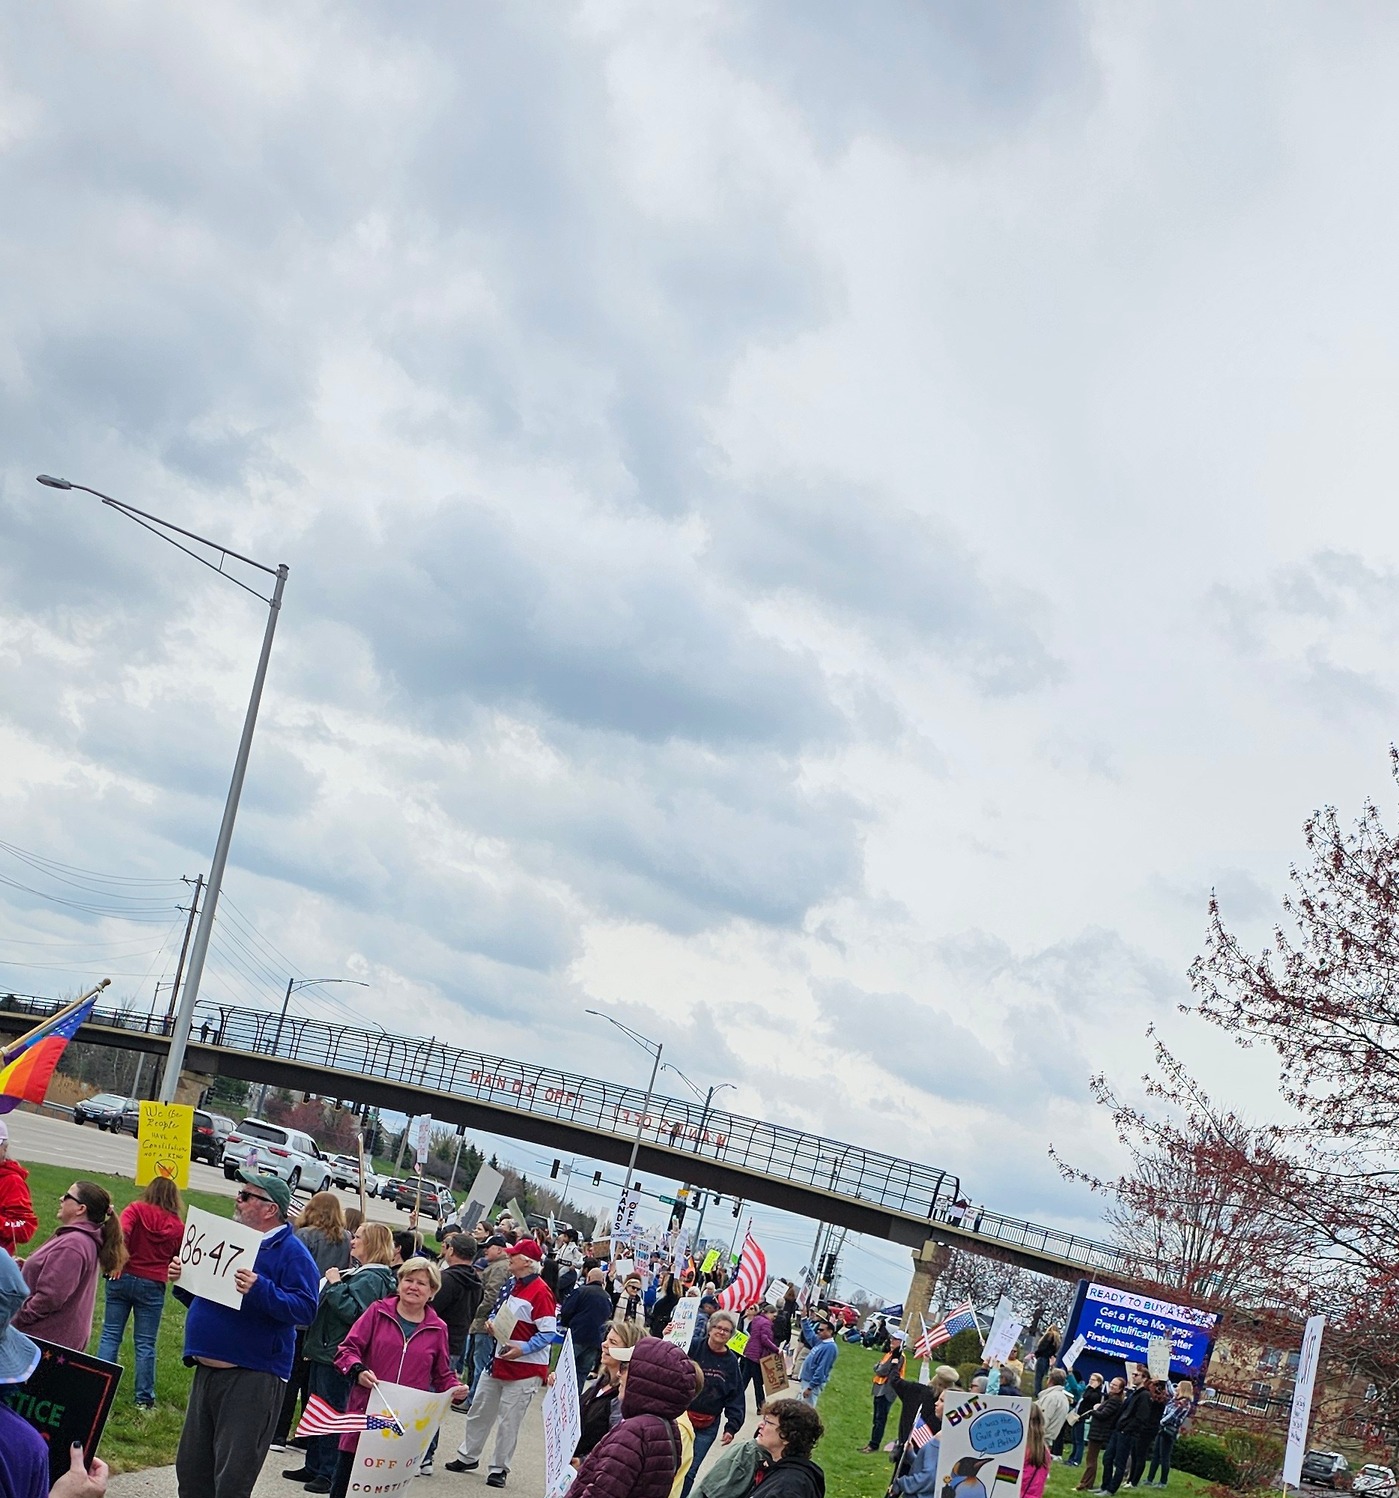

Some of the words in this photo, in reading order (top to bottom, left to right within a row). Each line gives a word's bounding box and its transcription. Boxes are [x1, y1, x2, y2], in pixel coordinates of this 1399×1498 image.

[468, 1069, 537, 1098] HANDS
[145, 1105, 163, 1117] We
[168, 1109, 183, 1119] the
[146, 1118, 180, 1130] People
[152, 1132, 168, 1140] HAVE
[142, 1139, 188, 1152] Constitution
[167, 1152, 184, 1160] KING
[613, 1188, 630, 1231] HANDS
[625, 1201, 639, 1227] OFF
[1089, 1288, 1126, 1303] READY
[1128, 1296, 1141, 1307] TO
[1143, 1301, 1166, 1313] BUY
[1100, 1306, 1118, 1319] Get
[1118, 1313, 1126, 1321] a
[1127, 1312, 1149, 1326] Free
[1094, 1318, 1164, 1342] Prequalification
[945, 1395, 987, 1427] BUT,
[976, 1430, 992, 1442] Gulf
[364, 1457, 398, 1469] OFF
